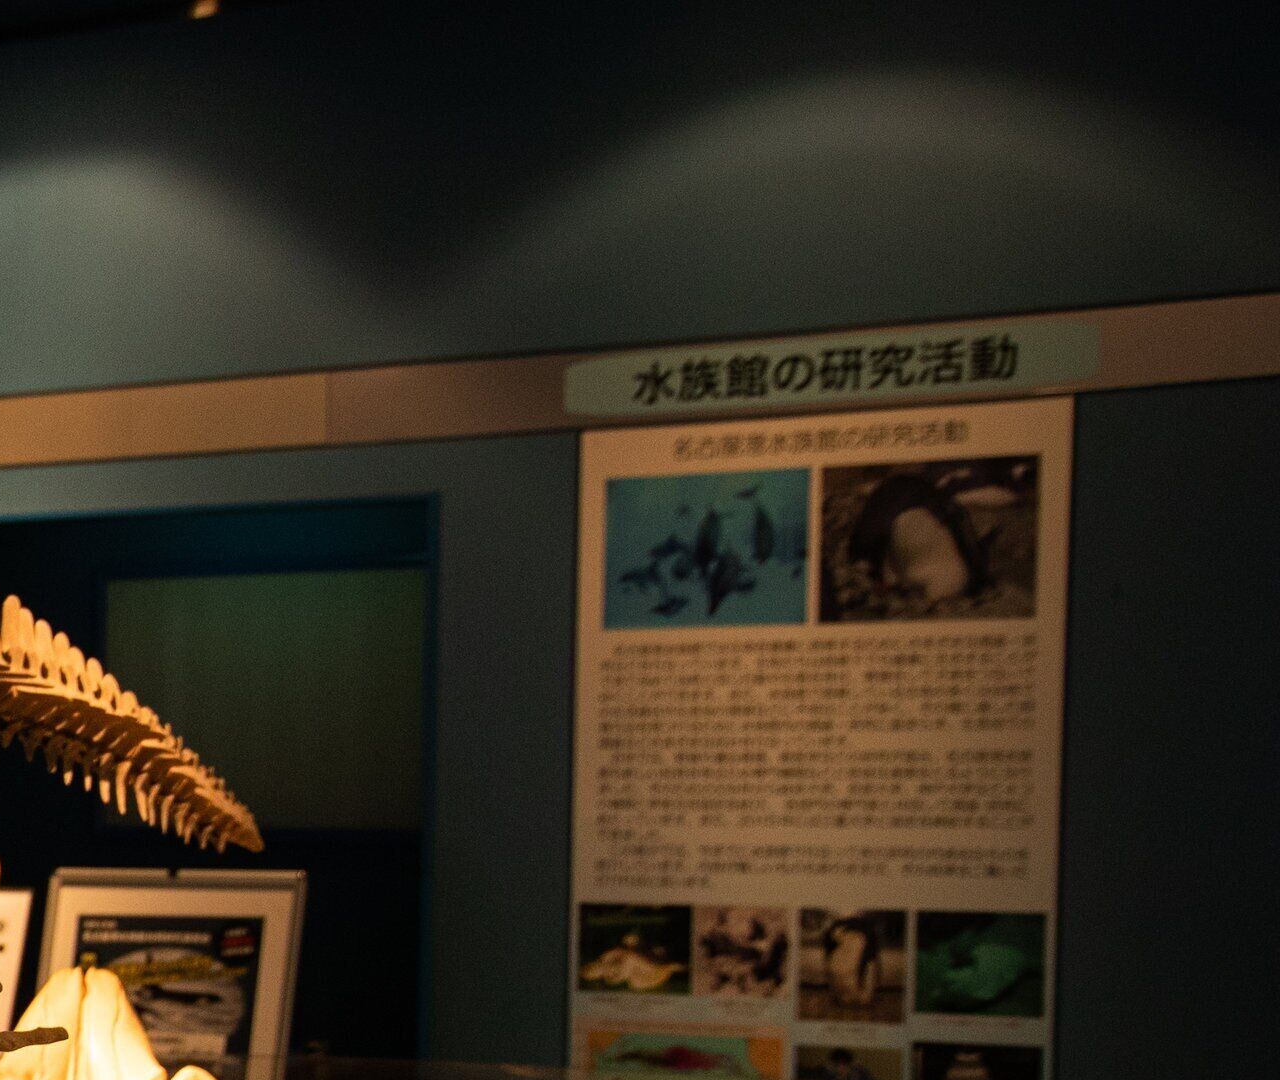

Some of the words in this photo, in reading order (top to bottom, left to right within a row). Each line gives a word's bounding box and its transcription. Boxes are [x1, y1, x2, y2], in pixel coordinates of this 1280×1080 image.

[633, 335, 1019, 402] 水族館の研究活動
